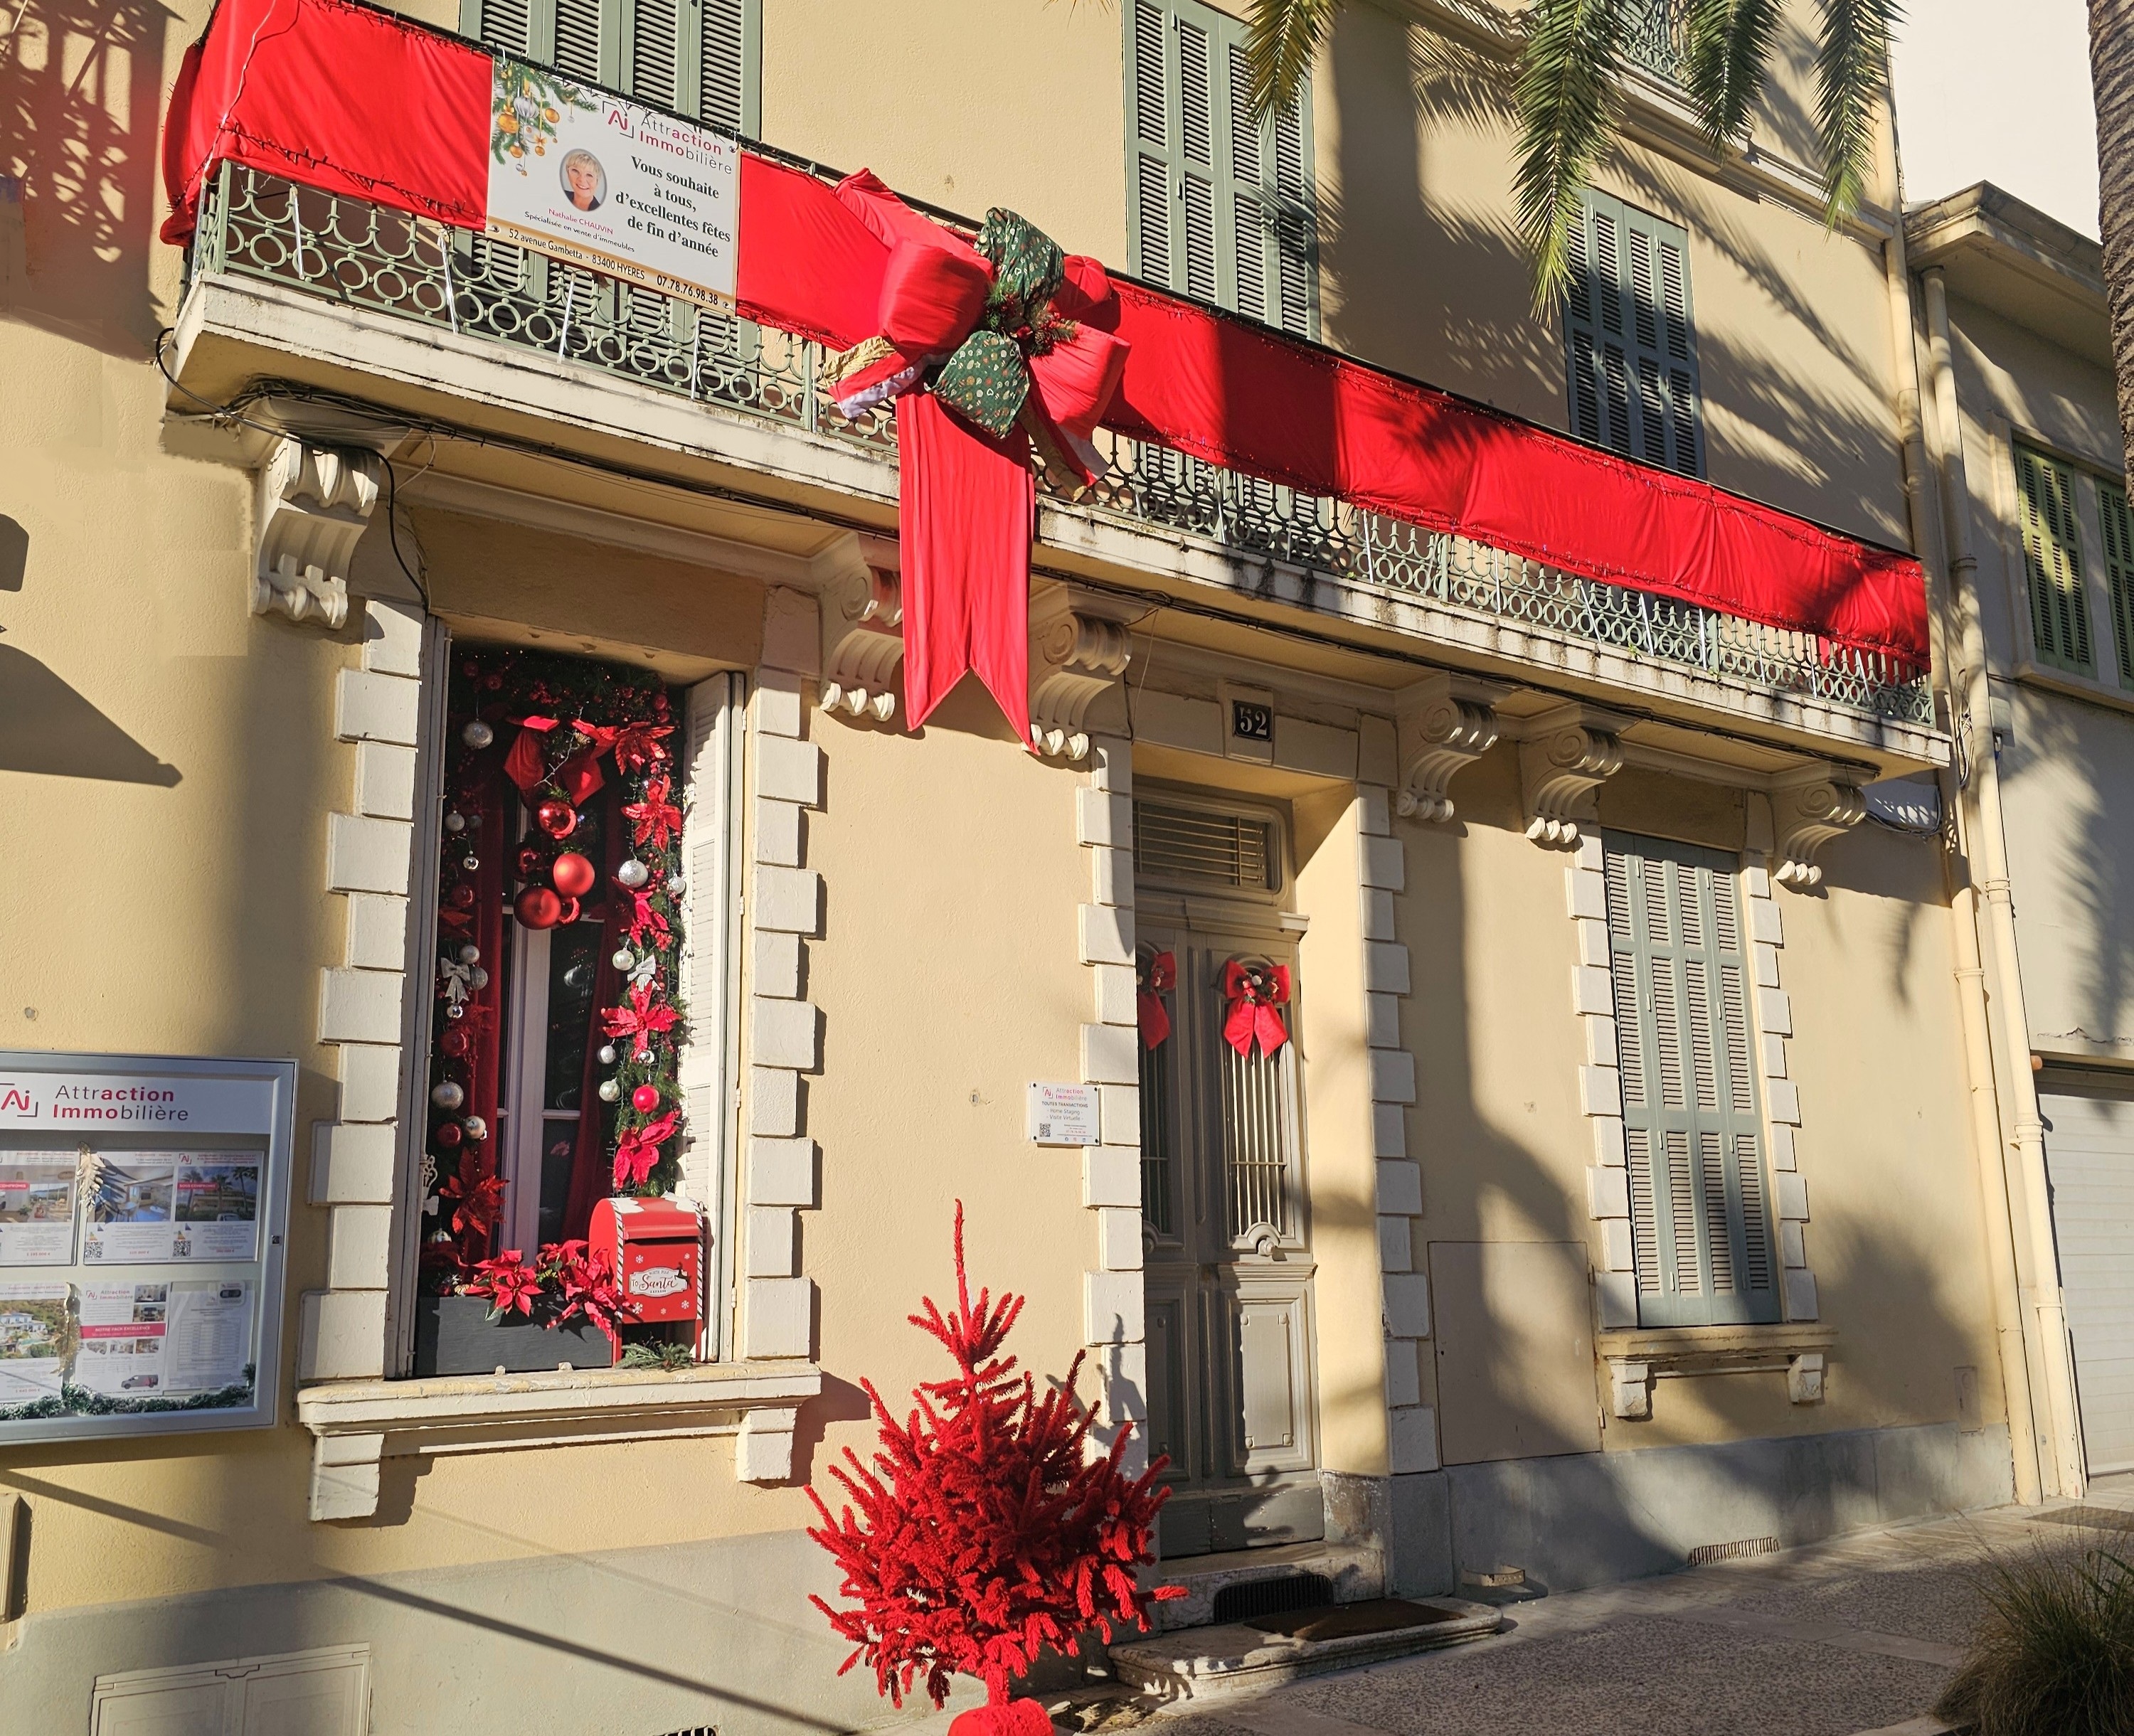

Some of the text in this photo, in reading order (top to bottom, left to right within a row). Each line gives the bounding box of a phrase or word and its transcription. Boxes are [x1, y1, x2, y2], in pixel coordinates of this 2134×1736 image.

[640, 131, 732, 174] Immobilière
[641, 117, 721, 155] Attraction
[631, 155, 719, 198] Vous souhaite
[654, 183, 696, 212] à tous,
[525, 211, 562, 228] Spécialisée
[573, 228, 591, 238] vente
[593, 233, 635, 252] d'immeubles
[548, 208, 613, 235] Nathalie CHAUVIN
[615, 191, 731, 243] d'excellentes fêtes
[627, 215, 718, 257] de fin d'année
[509, 228, 519, 240] 52
[520, 235, 546, 248] avenue
[548, 240, 583, 260] Gambetta
[592, 254, 615, 270] 83400
[617, 262, 645, 279] HYERES
[657, 275, 718, 306] 07.78.76.98.38
[1240, 707, 1267, 736] 52
[53, 1104, 189, 1121] Immobilière
[55, 1085, 174, 1102] Attraction
[639, 1274, 679, 1291] Santa
